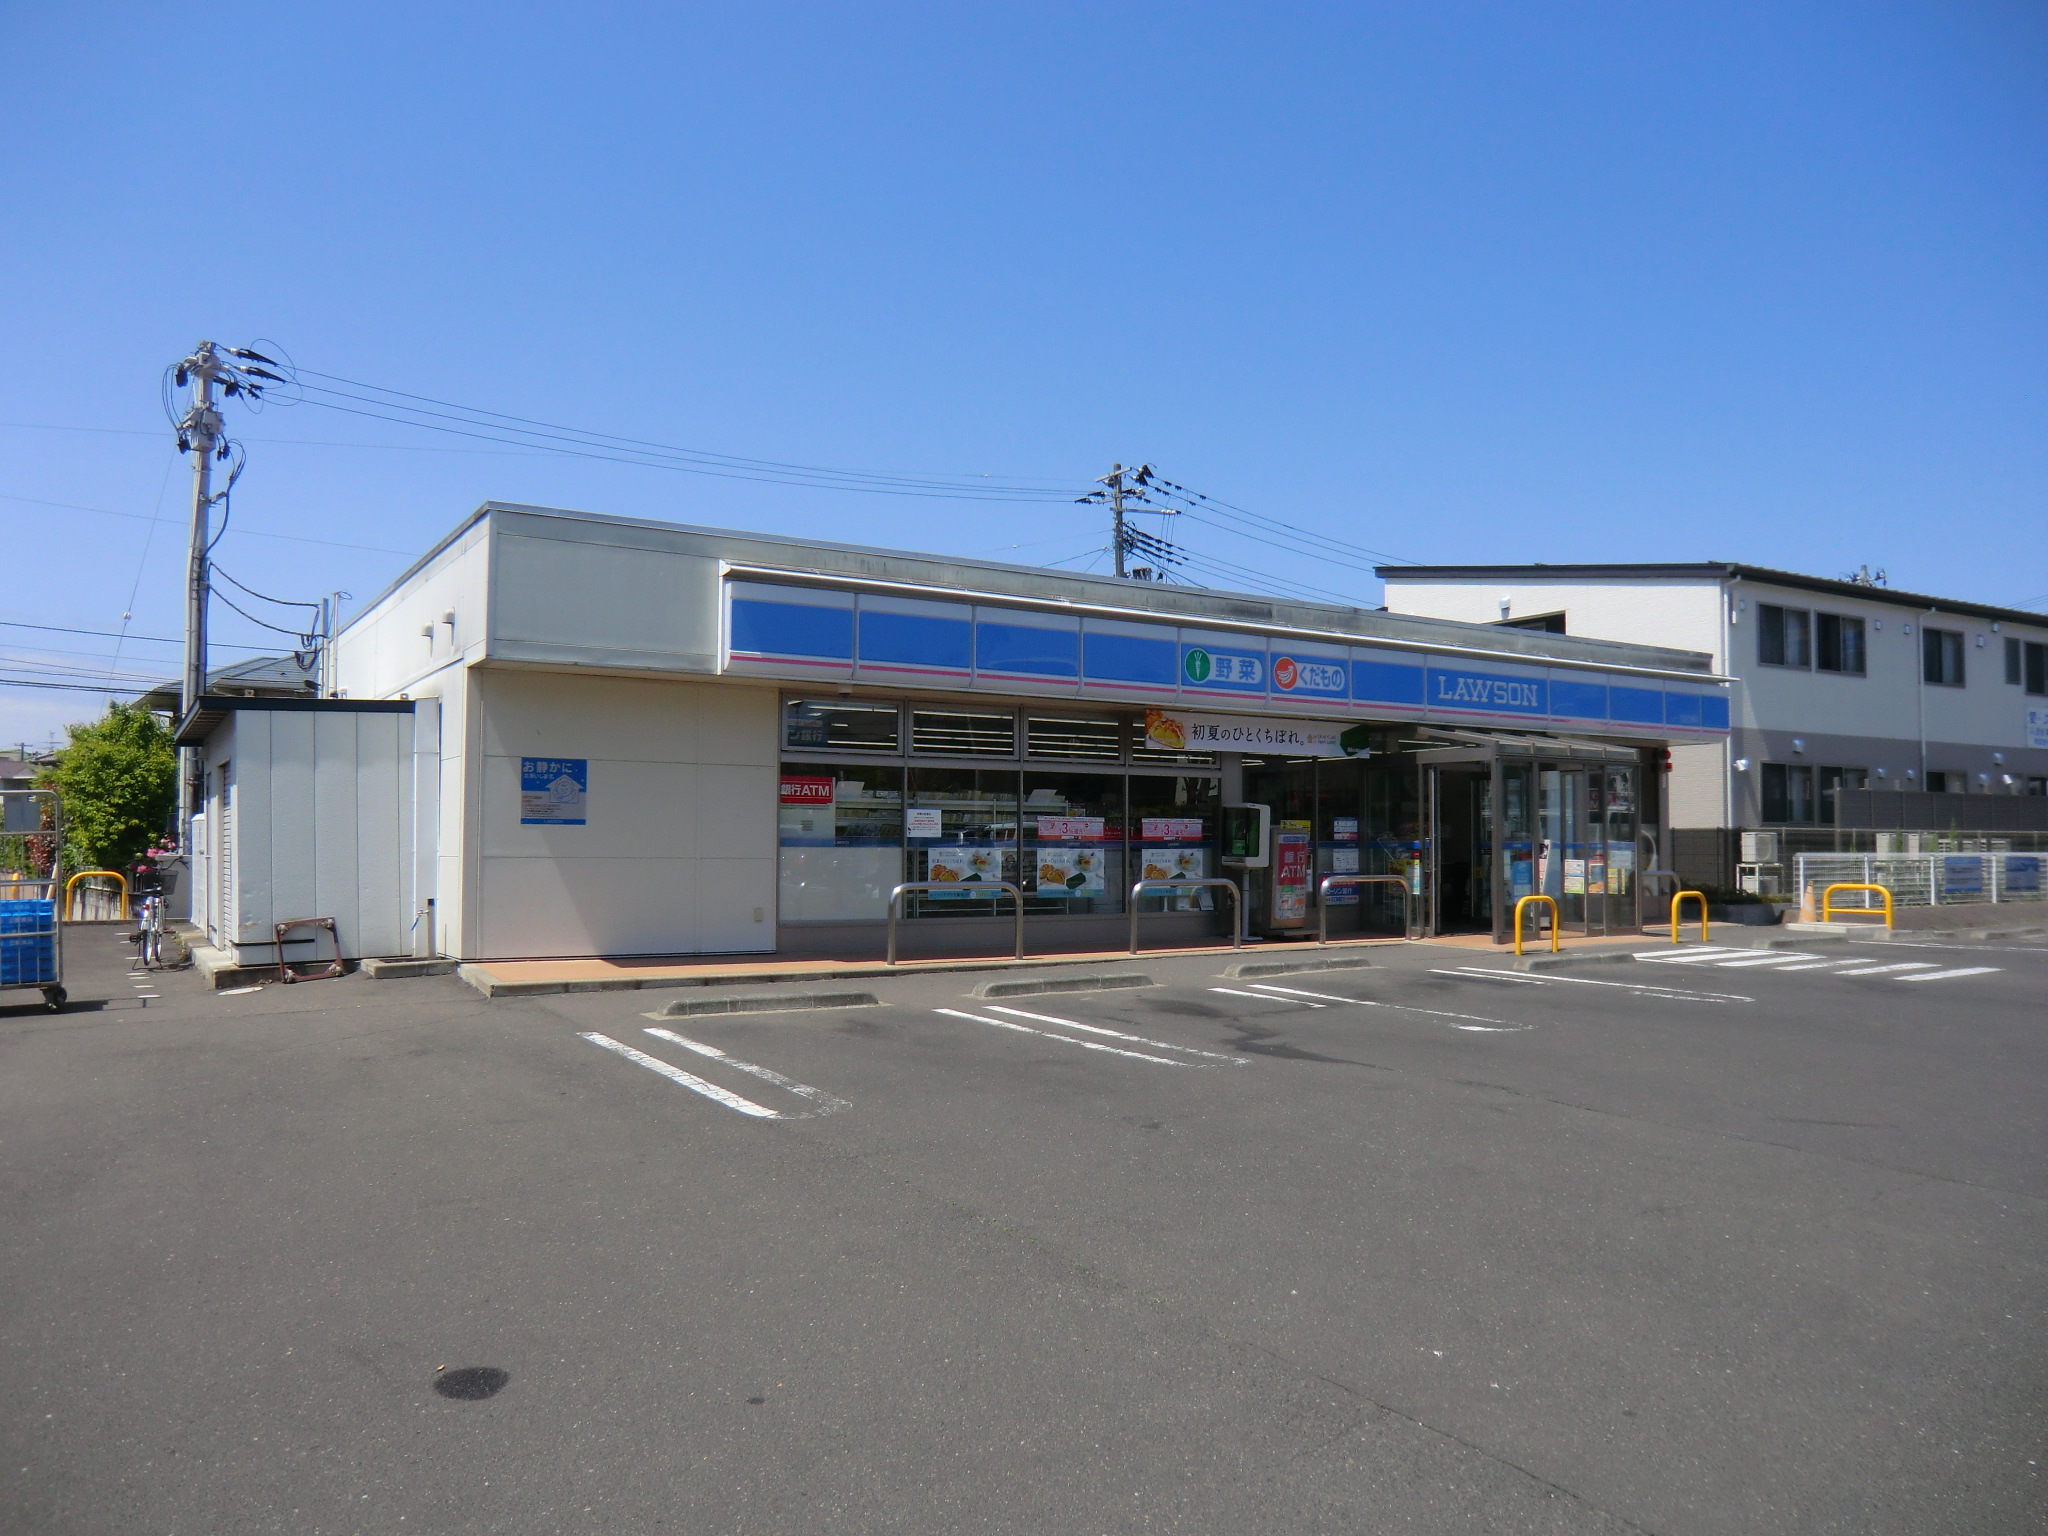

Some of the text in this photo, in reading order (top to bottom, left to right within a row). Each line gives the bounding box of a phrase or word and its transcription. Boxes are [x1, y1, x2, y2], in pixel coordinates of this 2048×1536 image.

[1215, 658, 1256, 681] 野菜
[1300, 666, 1342, 688] くだもの
[1438, 676, 1538, 707] LAWSON
[1192, 723, 1305, 746] 初夏のひとくちぼれ。
[780, 784, 830, 797] 銀行ATM
[1284, 851, 1304, 863] 銀行
[1282, 865, 1305, 878] ATM
